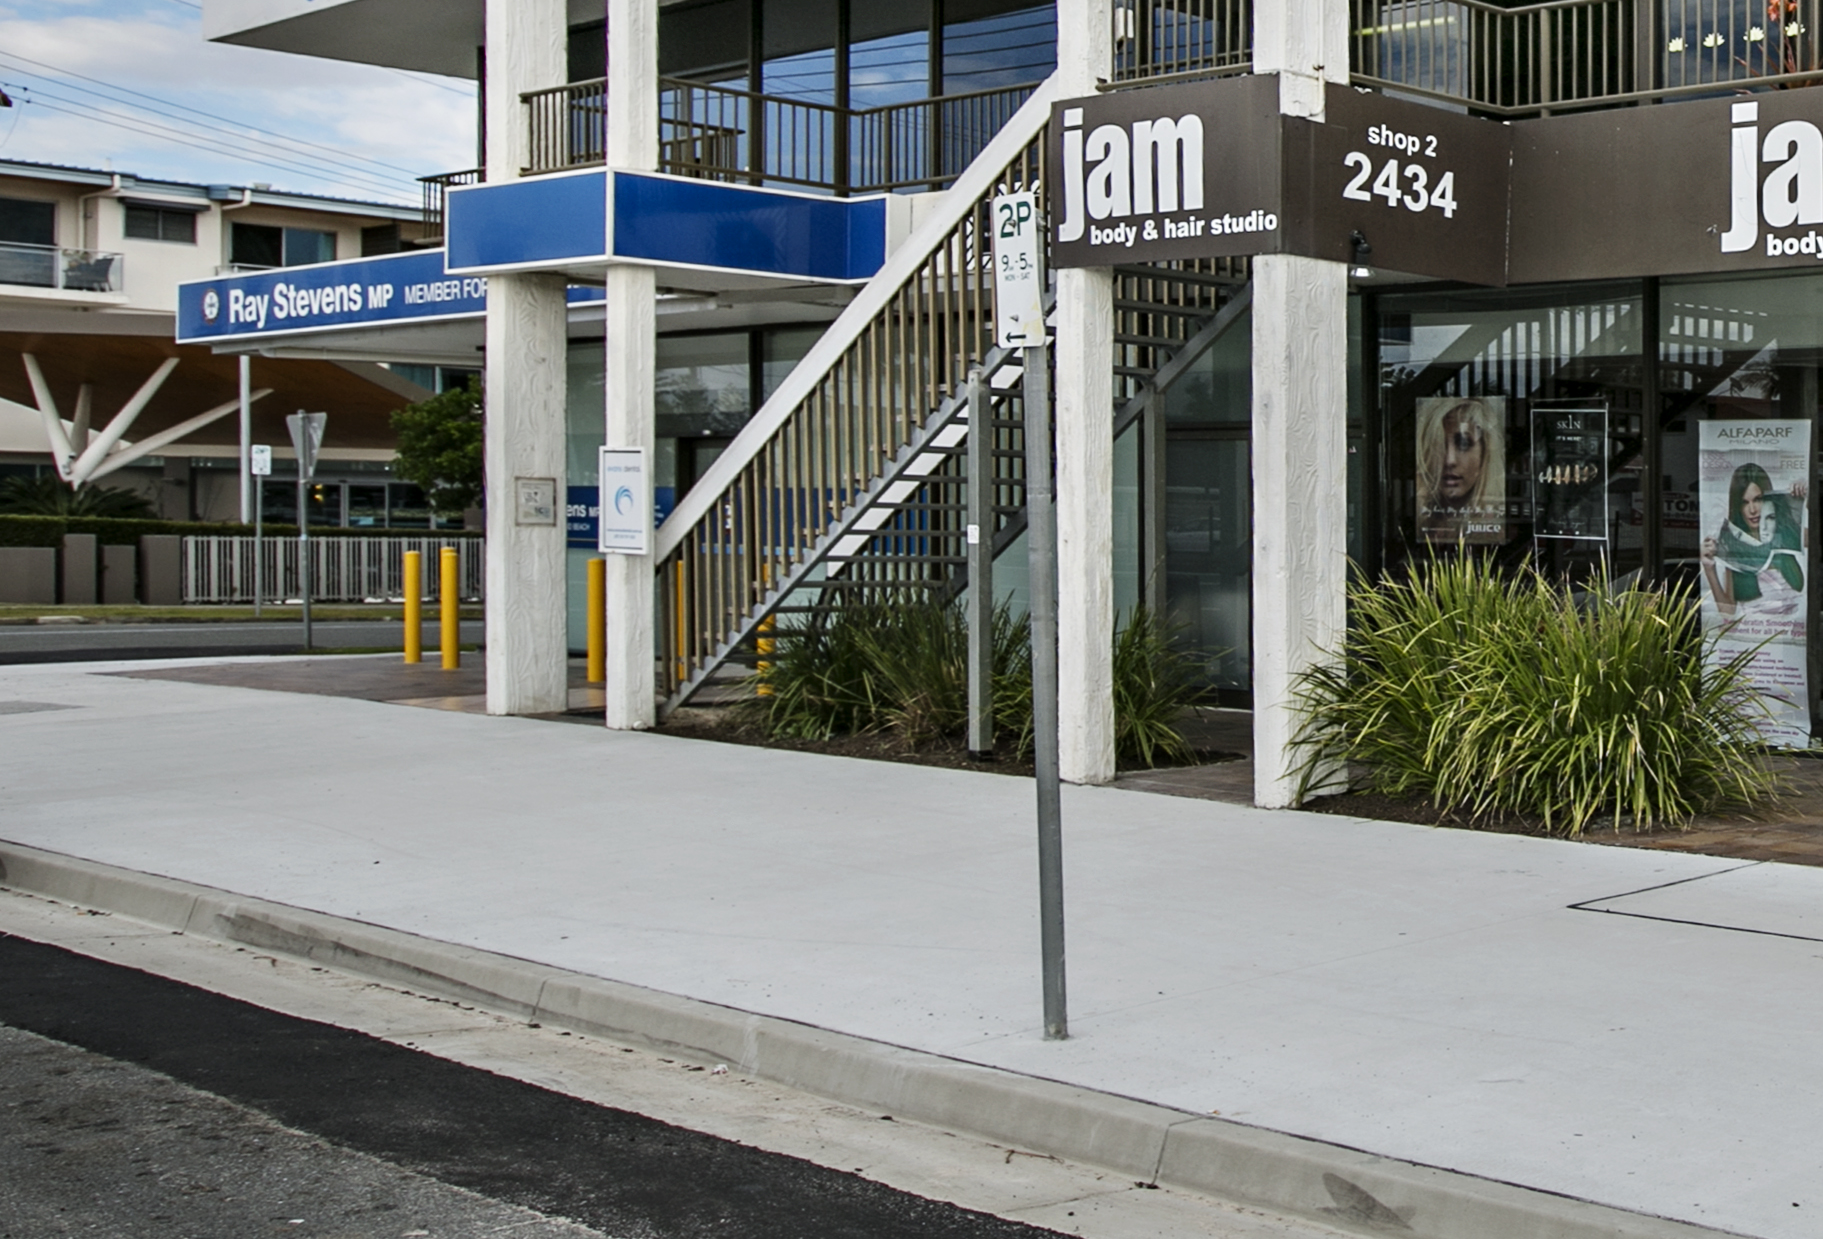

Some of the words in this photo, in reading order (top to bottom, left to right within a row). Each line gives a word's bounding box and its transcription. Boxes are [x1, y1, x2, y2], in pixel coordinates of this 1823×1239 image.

[1367, 123, 1421, 156] shop
[1424, 135, 1438, 157] 2
[1059, 107, 1204, 243] jam
[1342, 151, 1458, 219] 2434
[999, 200, 1031, 239] 2P
[1090, 221, 1136, 247] body
[1142, 219, 1158, 242] &
[1164, 217, 1205, 240] hair
[1210, 210, 1278, 236] studio
[228, 288, 270, 329] Ray
[272, 281, 363, 319] Stevens
[368, 284, 393, 310] MP
[405, 281, 462, 305] MEMBER
[1717, 426, 1794, 439] ALFAPARF
[1779, 459, 1805, 470] FREE
[1465, 521, 1501, 535] juuce
